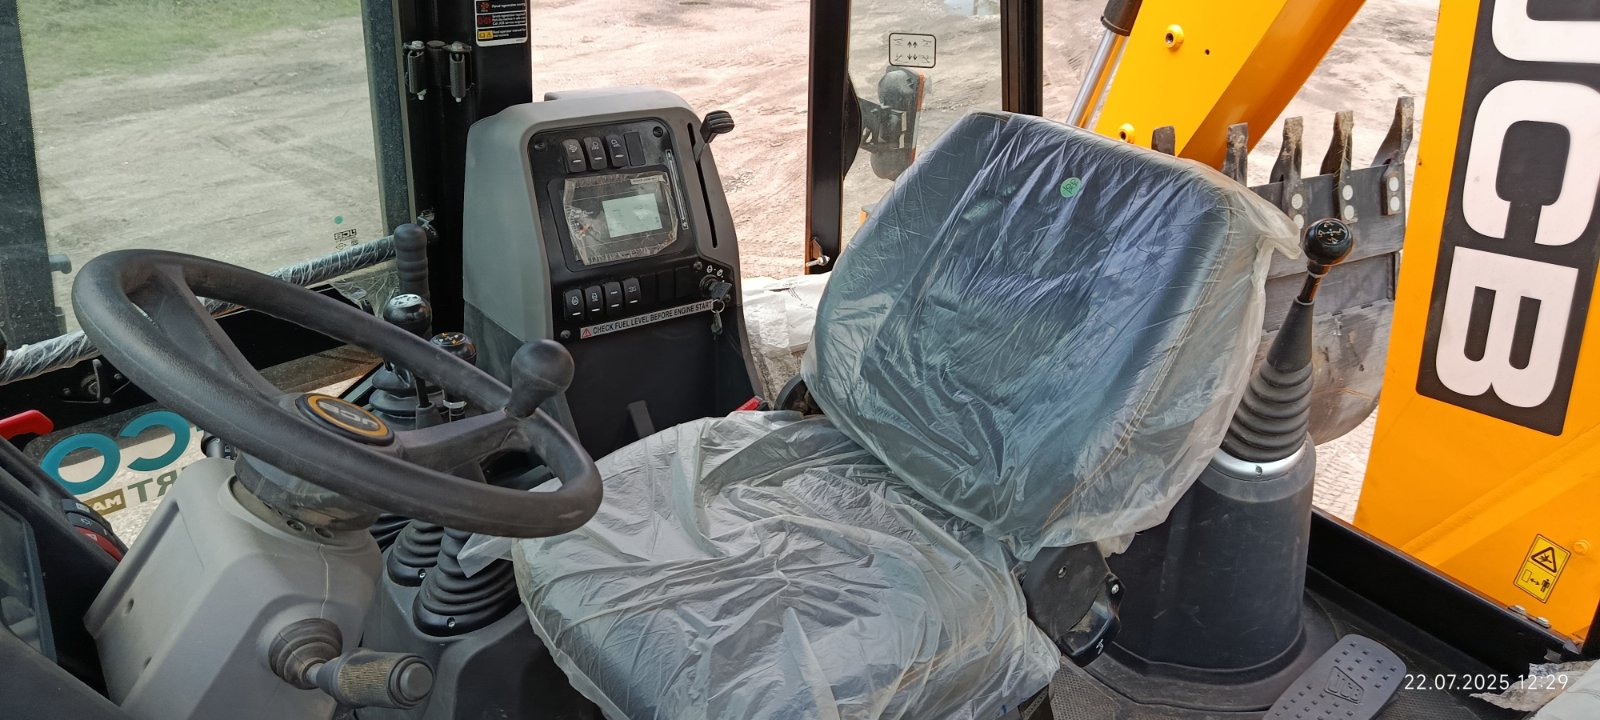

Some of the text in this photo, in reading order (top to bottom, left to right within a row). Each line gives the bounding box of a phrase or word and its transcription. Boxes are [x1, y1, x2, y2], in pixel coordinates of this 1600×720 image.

[593, 300, 712, 335] CHECK FUEL LEVEL BEFORE ENGINE START
